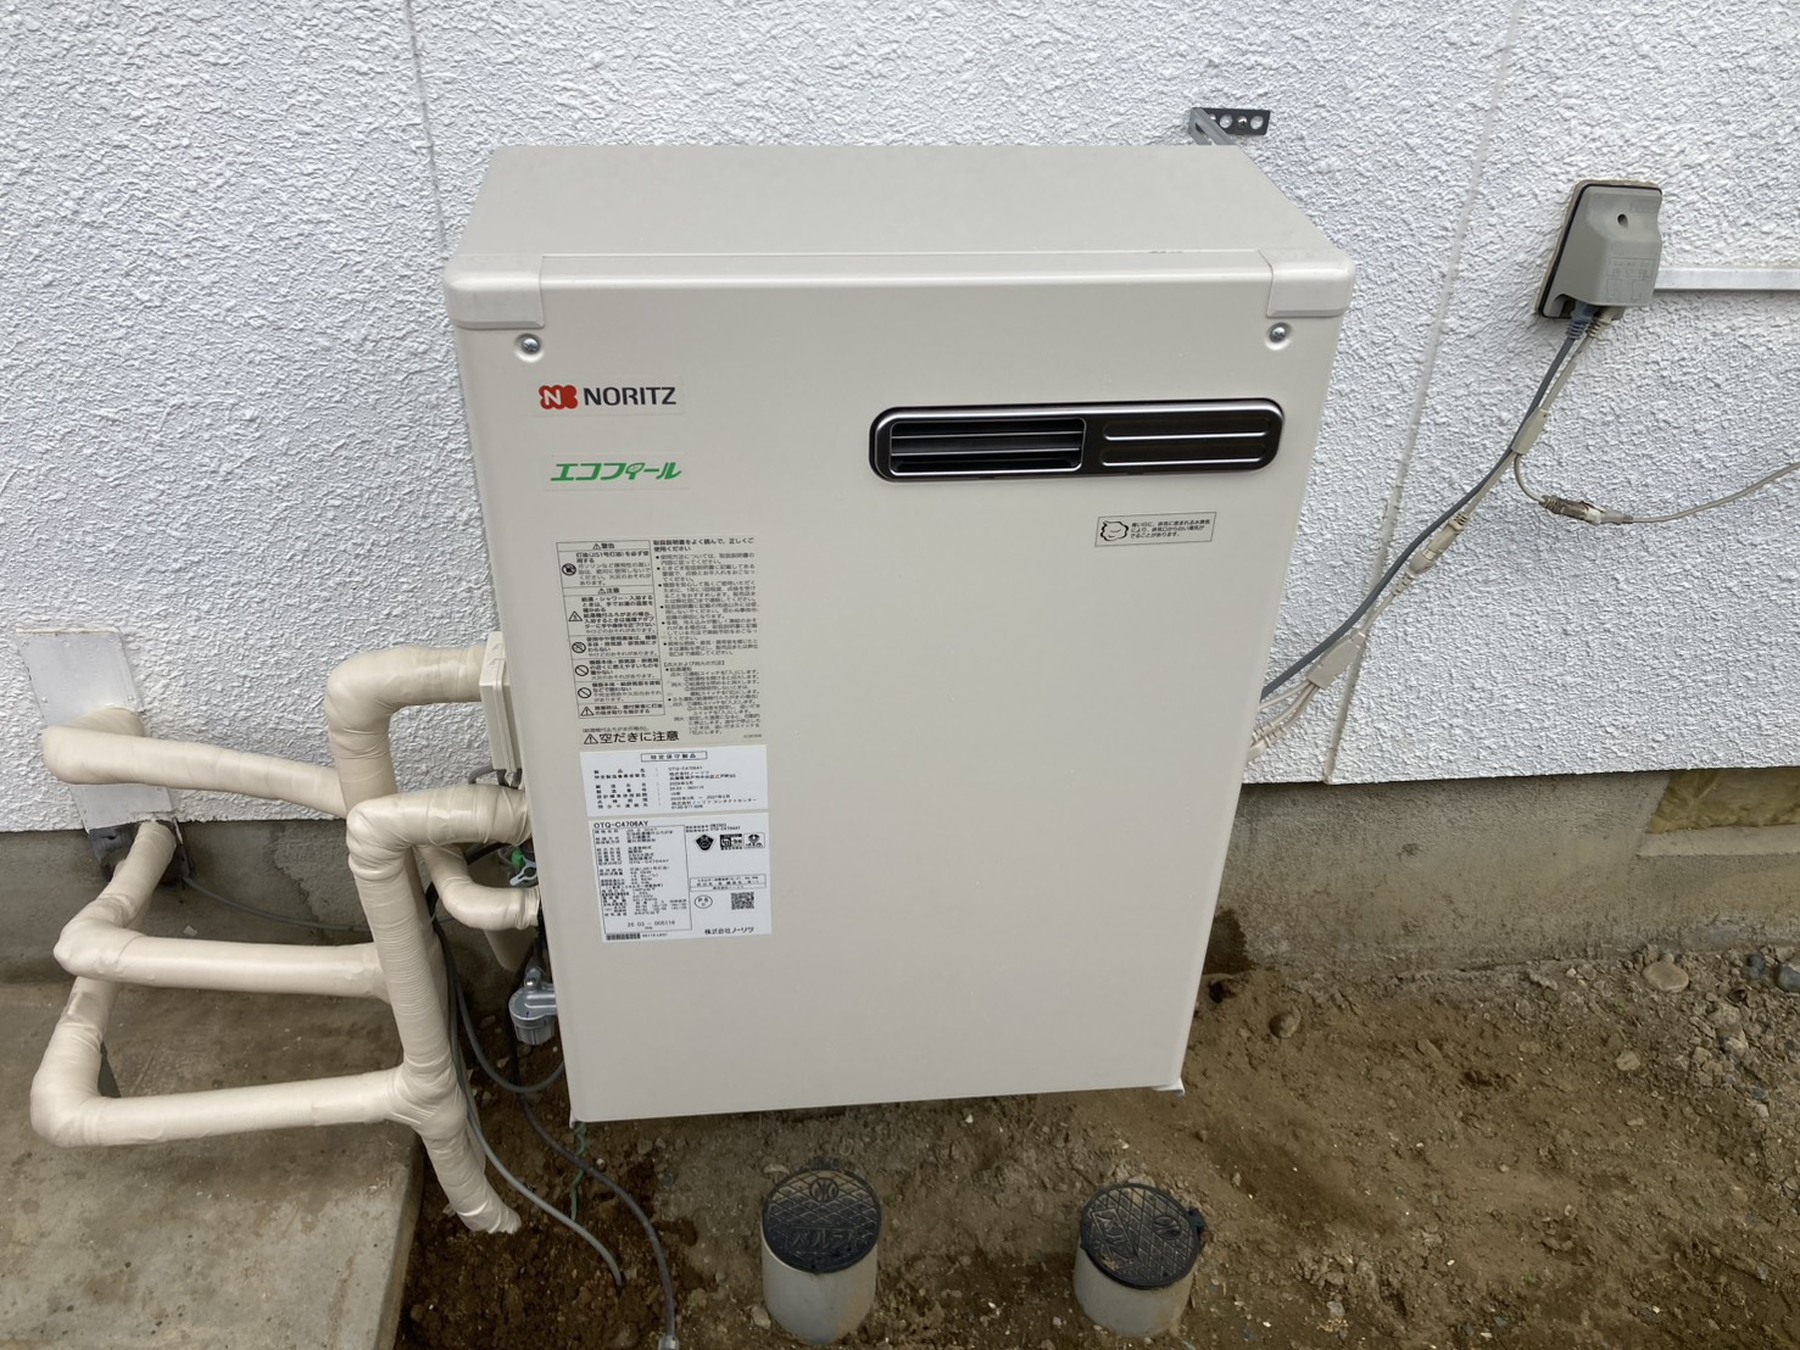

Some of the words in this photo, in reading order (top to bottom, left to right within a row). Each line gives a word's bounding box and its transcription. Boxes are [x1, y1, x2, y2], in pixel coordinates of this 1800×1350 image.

[584, 387, 676, 406] NORITZ
[550, 462, 682, 481] エコフィール
[599, 730, 679, 744] 空だきに注意
